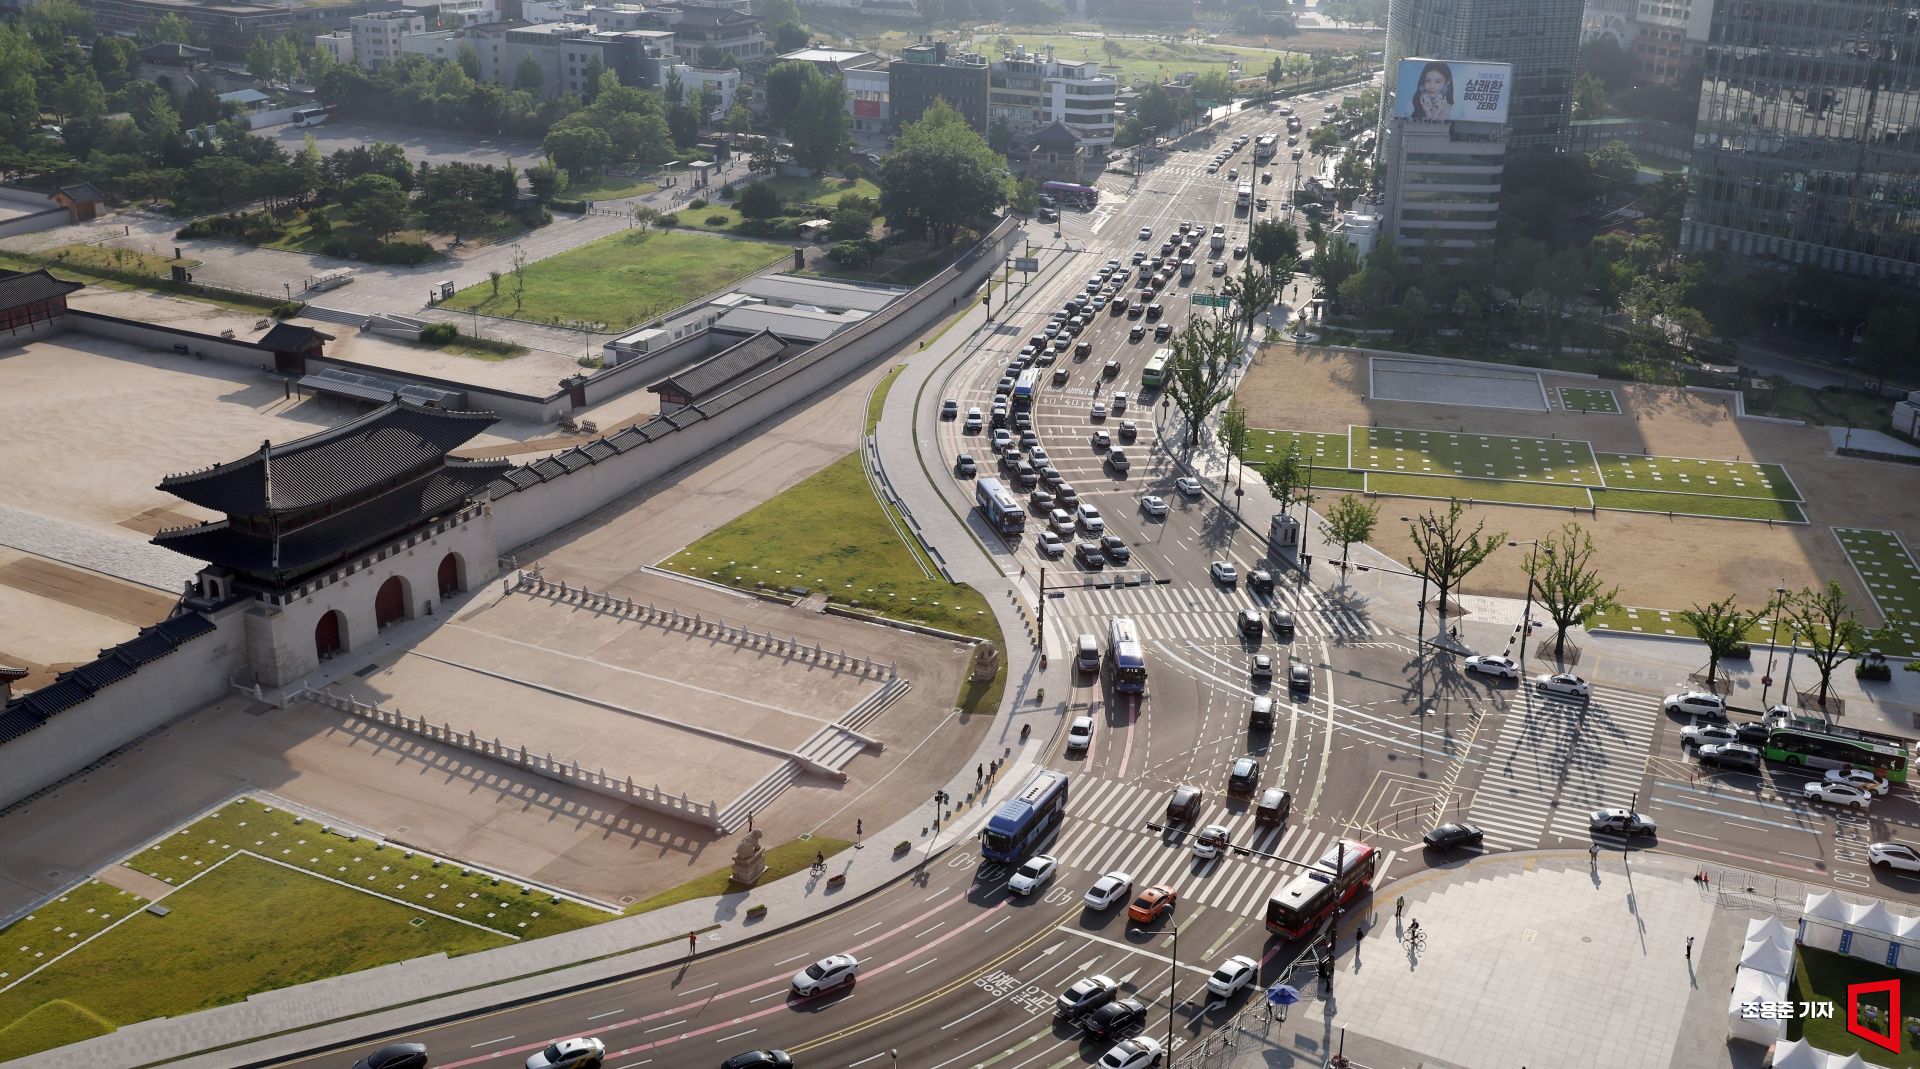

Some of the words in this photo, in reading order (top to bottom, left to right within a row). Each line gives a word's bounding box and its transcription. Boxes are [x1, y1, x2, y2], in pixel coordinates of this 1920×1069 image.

[1465, 79, 1503, 93] 상쾌환
[1464, 93, 1500, 102] BOOSTER
[1476, 102, 1498, 110] ZERO
